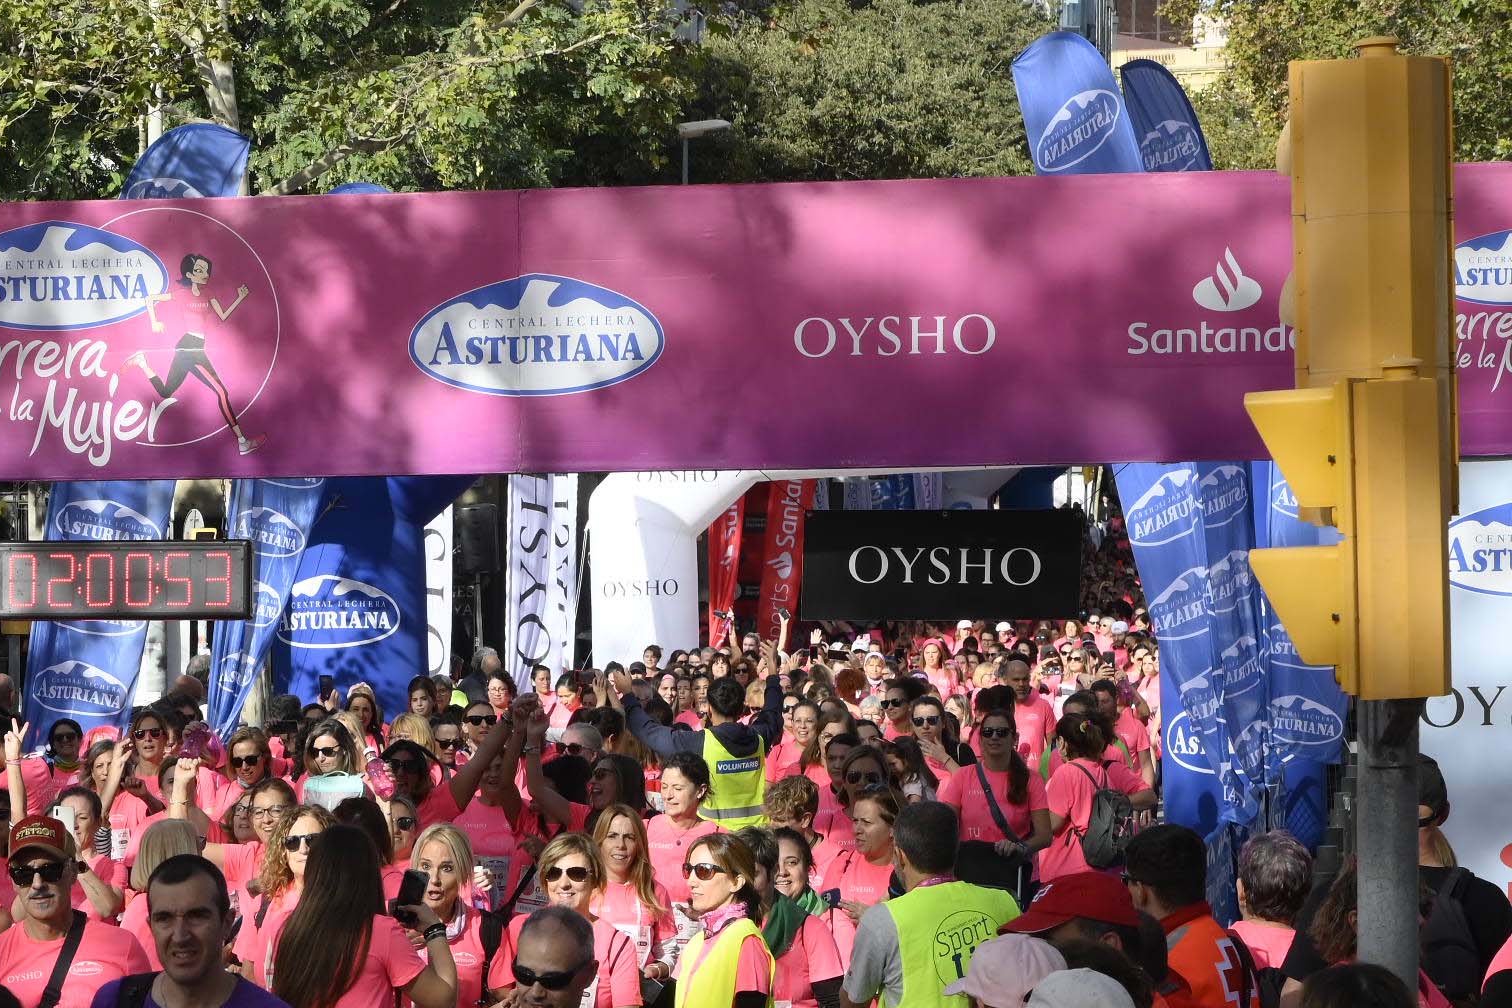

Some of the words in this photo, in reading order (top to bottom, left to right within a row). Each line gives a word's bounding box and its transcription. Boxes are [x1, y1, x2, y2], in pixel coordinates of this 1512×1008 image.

[71, 257, 144, 270] LECHERA
[468, 315, 545, 330] CENTRAL
[554, 314, 636, 328] LECHERA
[793, 312, 996, 359] OYSHO
[427, 320, 644, 366] ASTURIANA
[1477, 340, 1496, 369] la
[9, 382, 35, 422] la
[28, 367, 178, 468] Mujer
[62, 510, 153, 541] ASTURIANA
[236, 519, 297, 552] AURIANA
[1474, 533, 1512, 544] CENT
[6, 551, 233, 610] 02:00:53
[516, 472, 552, 668] OYSH
[848, 544, 1042, 588] OYSHO
[603, 578, 679, 599] OYSHO
[291, 600, 333, 609] CENTRAL
[337, 600, 387, 608] LECHERA
[769, 582, 790, 643] ports
[279, 610, 392, 632] ASTURIANA
[35, 676, 123, 710] ASTURIANA
[1272, 716, 1336, 737] STURIANA
[717, 760, 759, 772] VOLUNTARIS
[936, 915, 992, 958] Sport
[6, 970, 43, 984] OYSHO
